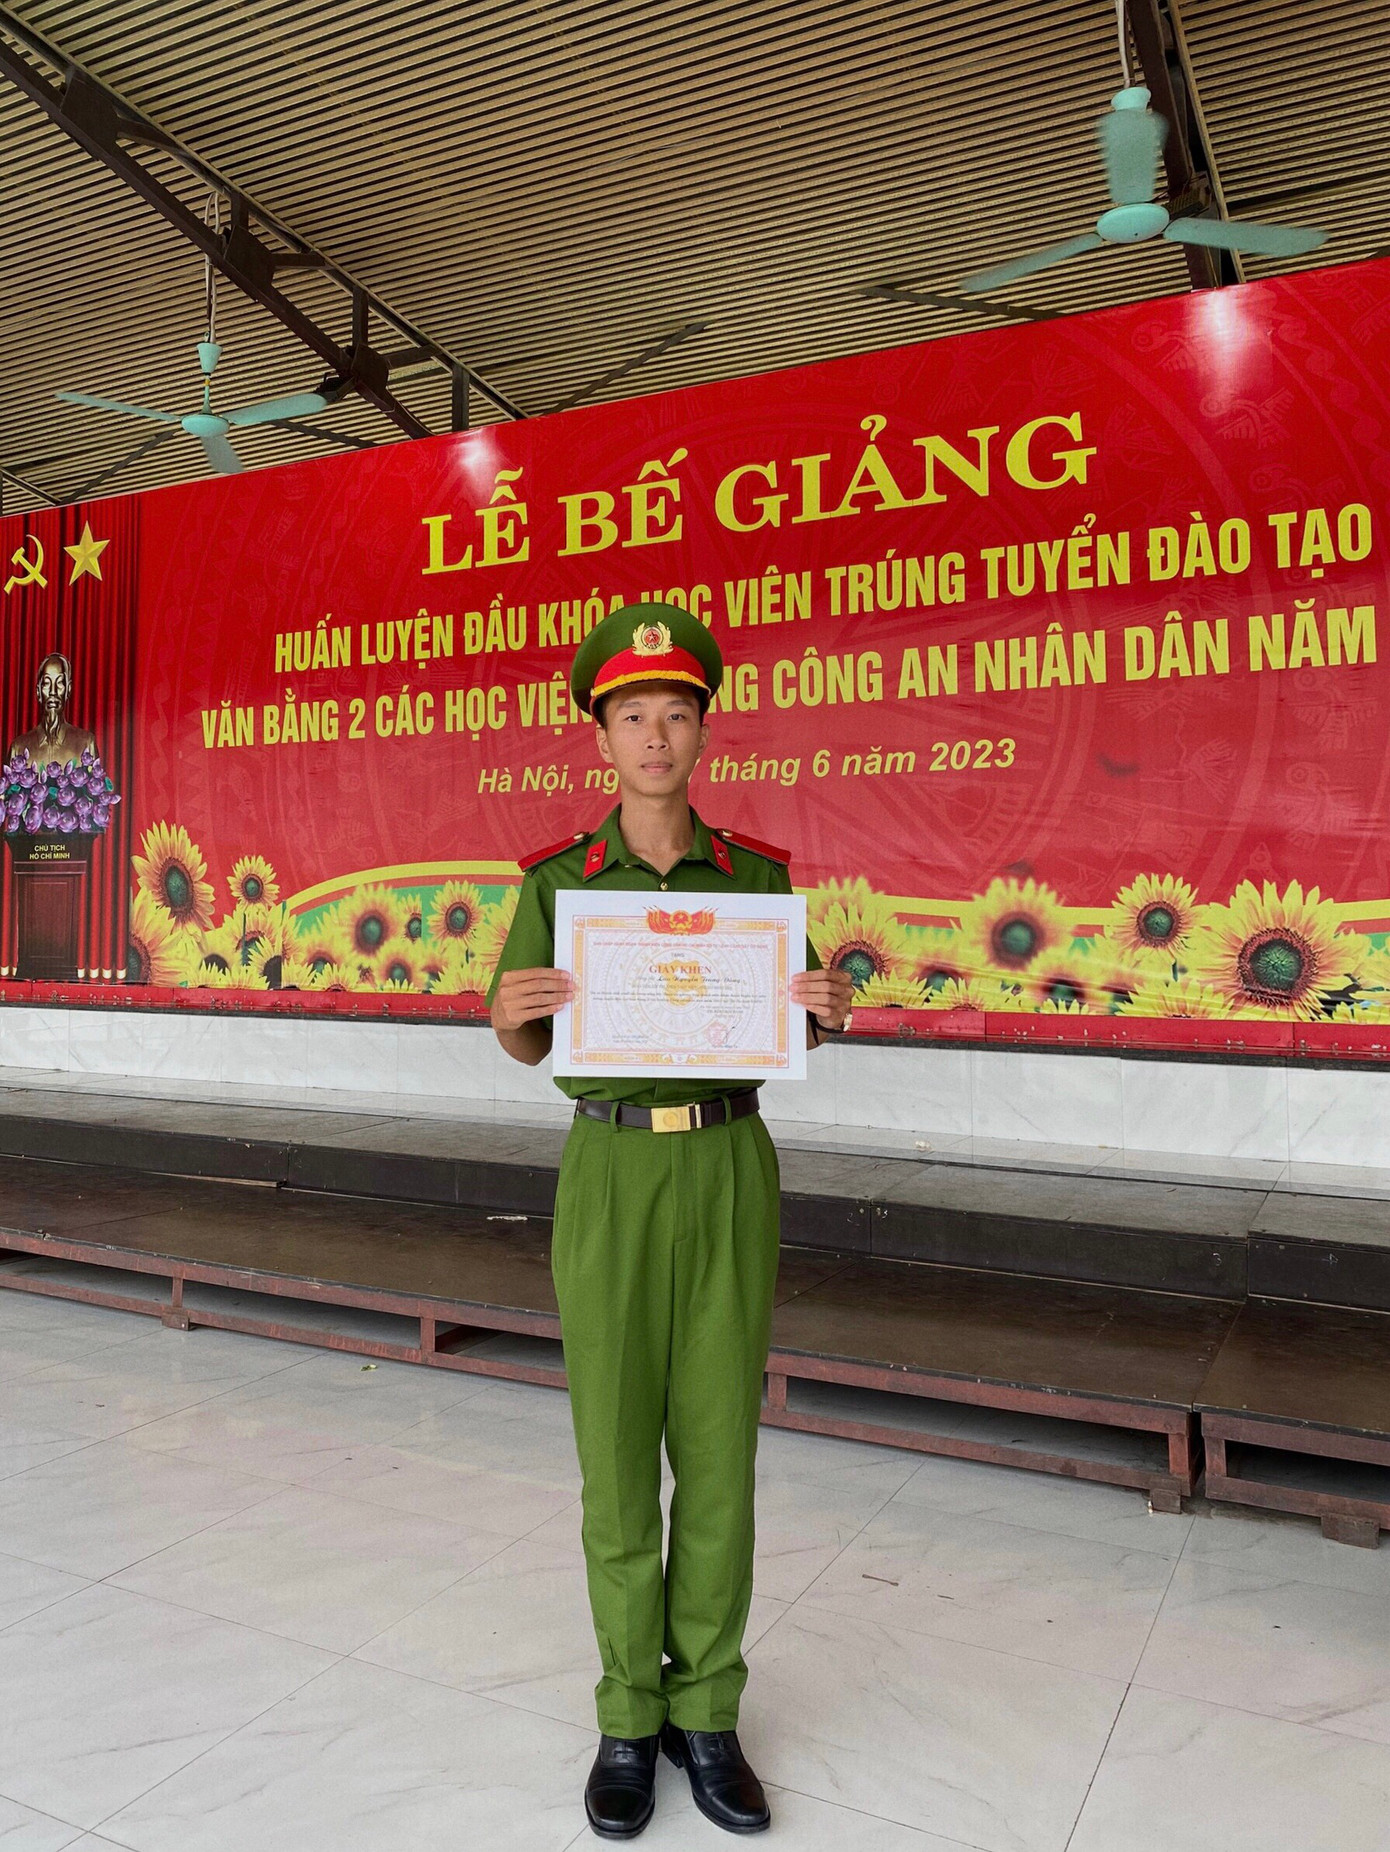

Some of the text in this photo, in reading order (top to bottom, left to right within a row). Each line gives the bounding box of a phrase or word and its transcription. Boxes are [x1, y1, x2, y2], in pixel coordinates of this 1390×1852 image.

[422, 412, 1096, 574] LỄ BẾ GIẢNG
[276, 614, 350, 672] HUẤN
[362, 609, 453, 669] LUYỆN
[464, 594, 526, 654] ĐẦU
[725, 566, 811, 627] VIÊN
[825, 549, 965, 615] TRÚNG
[981, 514, 1130, 598] TUYỂN
[1147, 512, 1250, 581] ĐÀO
[1269, 504, 1371, 578] TẠO
[202, 700, 253, 748] VĂN
[264, 688, 338, 744] BẰNG
[349, 699, 365, 739] 2
[376, 685, 434, 737] CÁC
[446, 686, 506, 740] HỌC
[773, 647, 883, 708] CÔNG
[898, 644, 958, 699] AN
[975, 623, 1106, 692] NHÂN
[1124, 611, 1229, 680] DÂN
[1249, 598, 1376, 671] NĂM
[478, 769, 512, 793] Hà
[522, 765, 573, 796] Nội,
[710, 754, 800, 786] tháng
[813, 750, 830, 777] 6
[842, 747, 915, 775] năm
[929, 738, 1015, 771] 2023
[53, 852, 70, 860] MINH
[680, 965, 712, 975] KHEN
